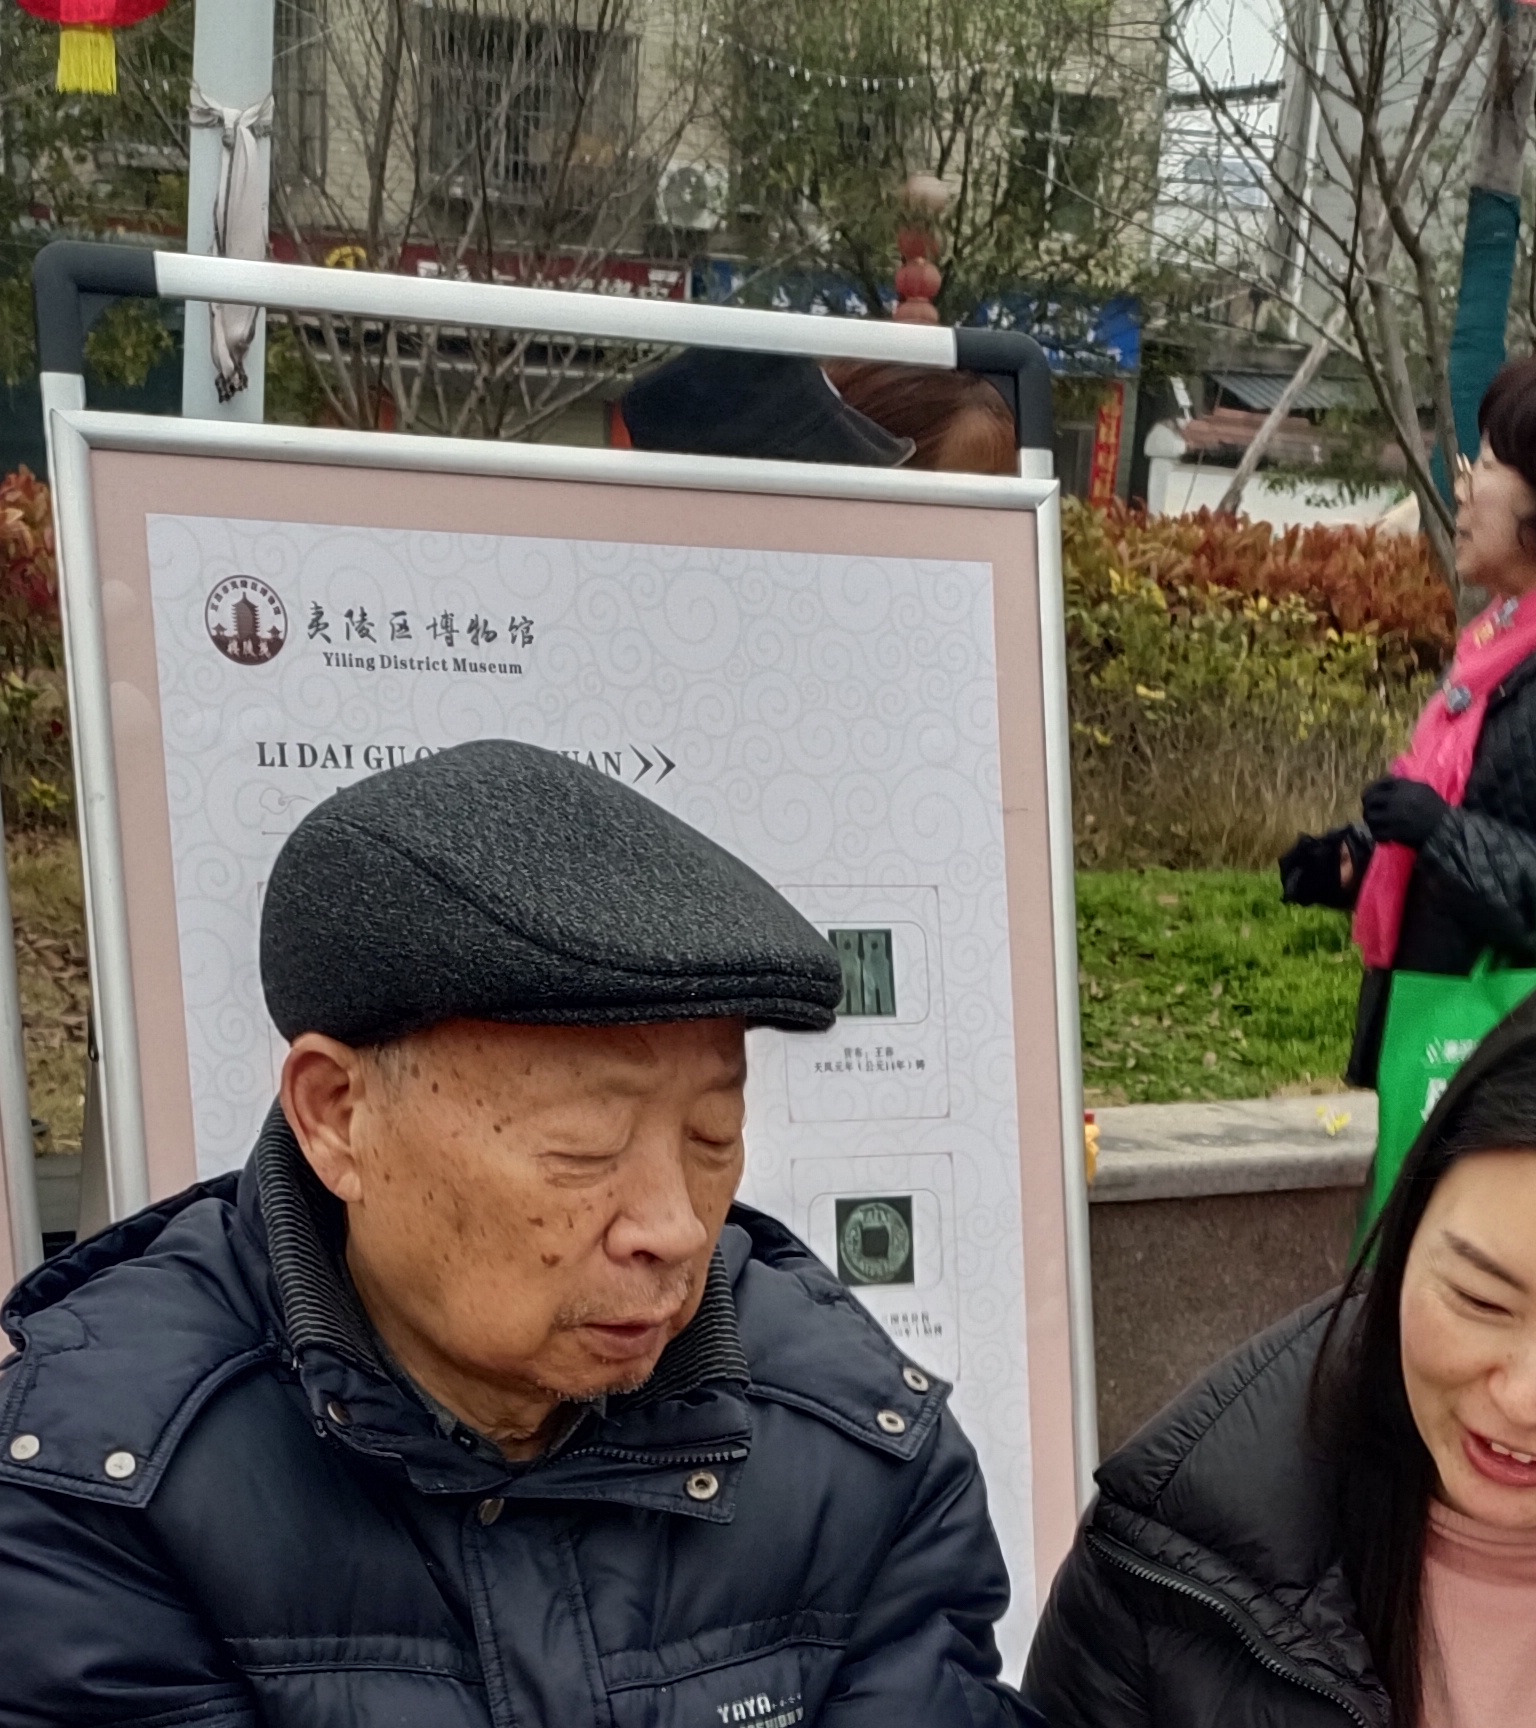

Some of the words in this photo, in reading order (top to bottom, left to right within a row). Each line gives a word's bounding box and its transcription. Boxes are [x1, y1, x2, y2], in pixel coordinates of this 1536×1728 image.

[307, 600, 535, 649] 夷陵区博物馆
[323, 651, 376, 672] Yiling
[379, 653, 448, 673] District
[453, 656, 523, 675] Museum
[257, 742, 289, 768] LI
[298, 743, 354, 770] DAI
[717, 1692, 771, 1724] YAYA
